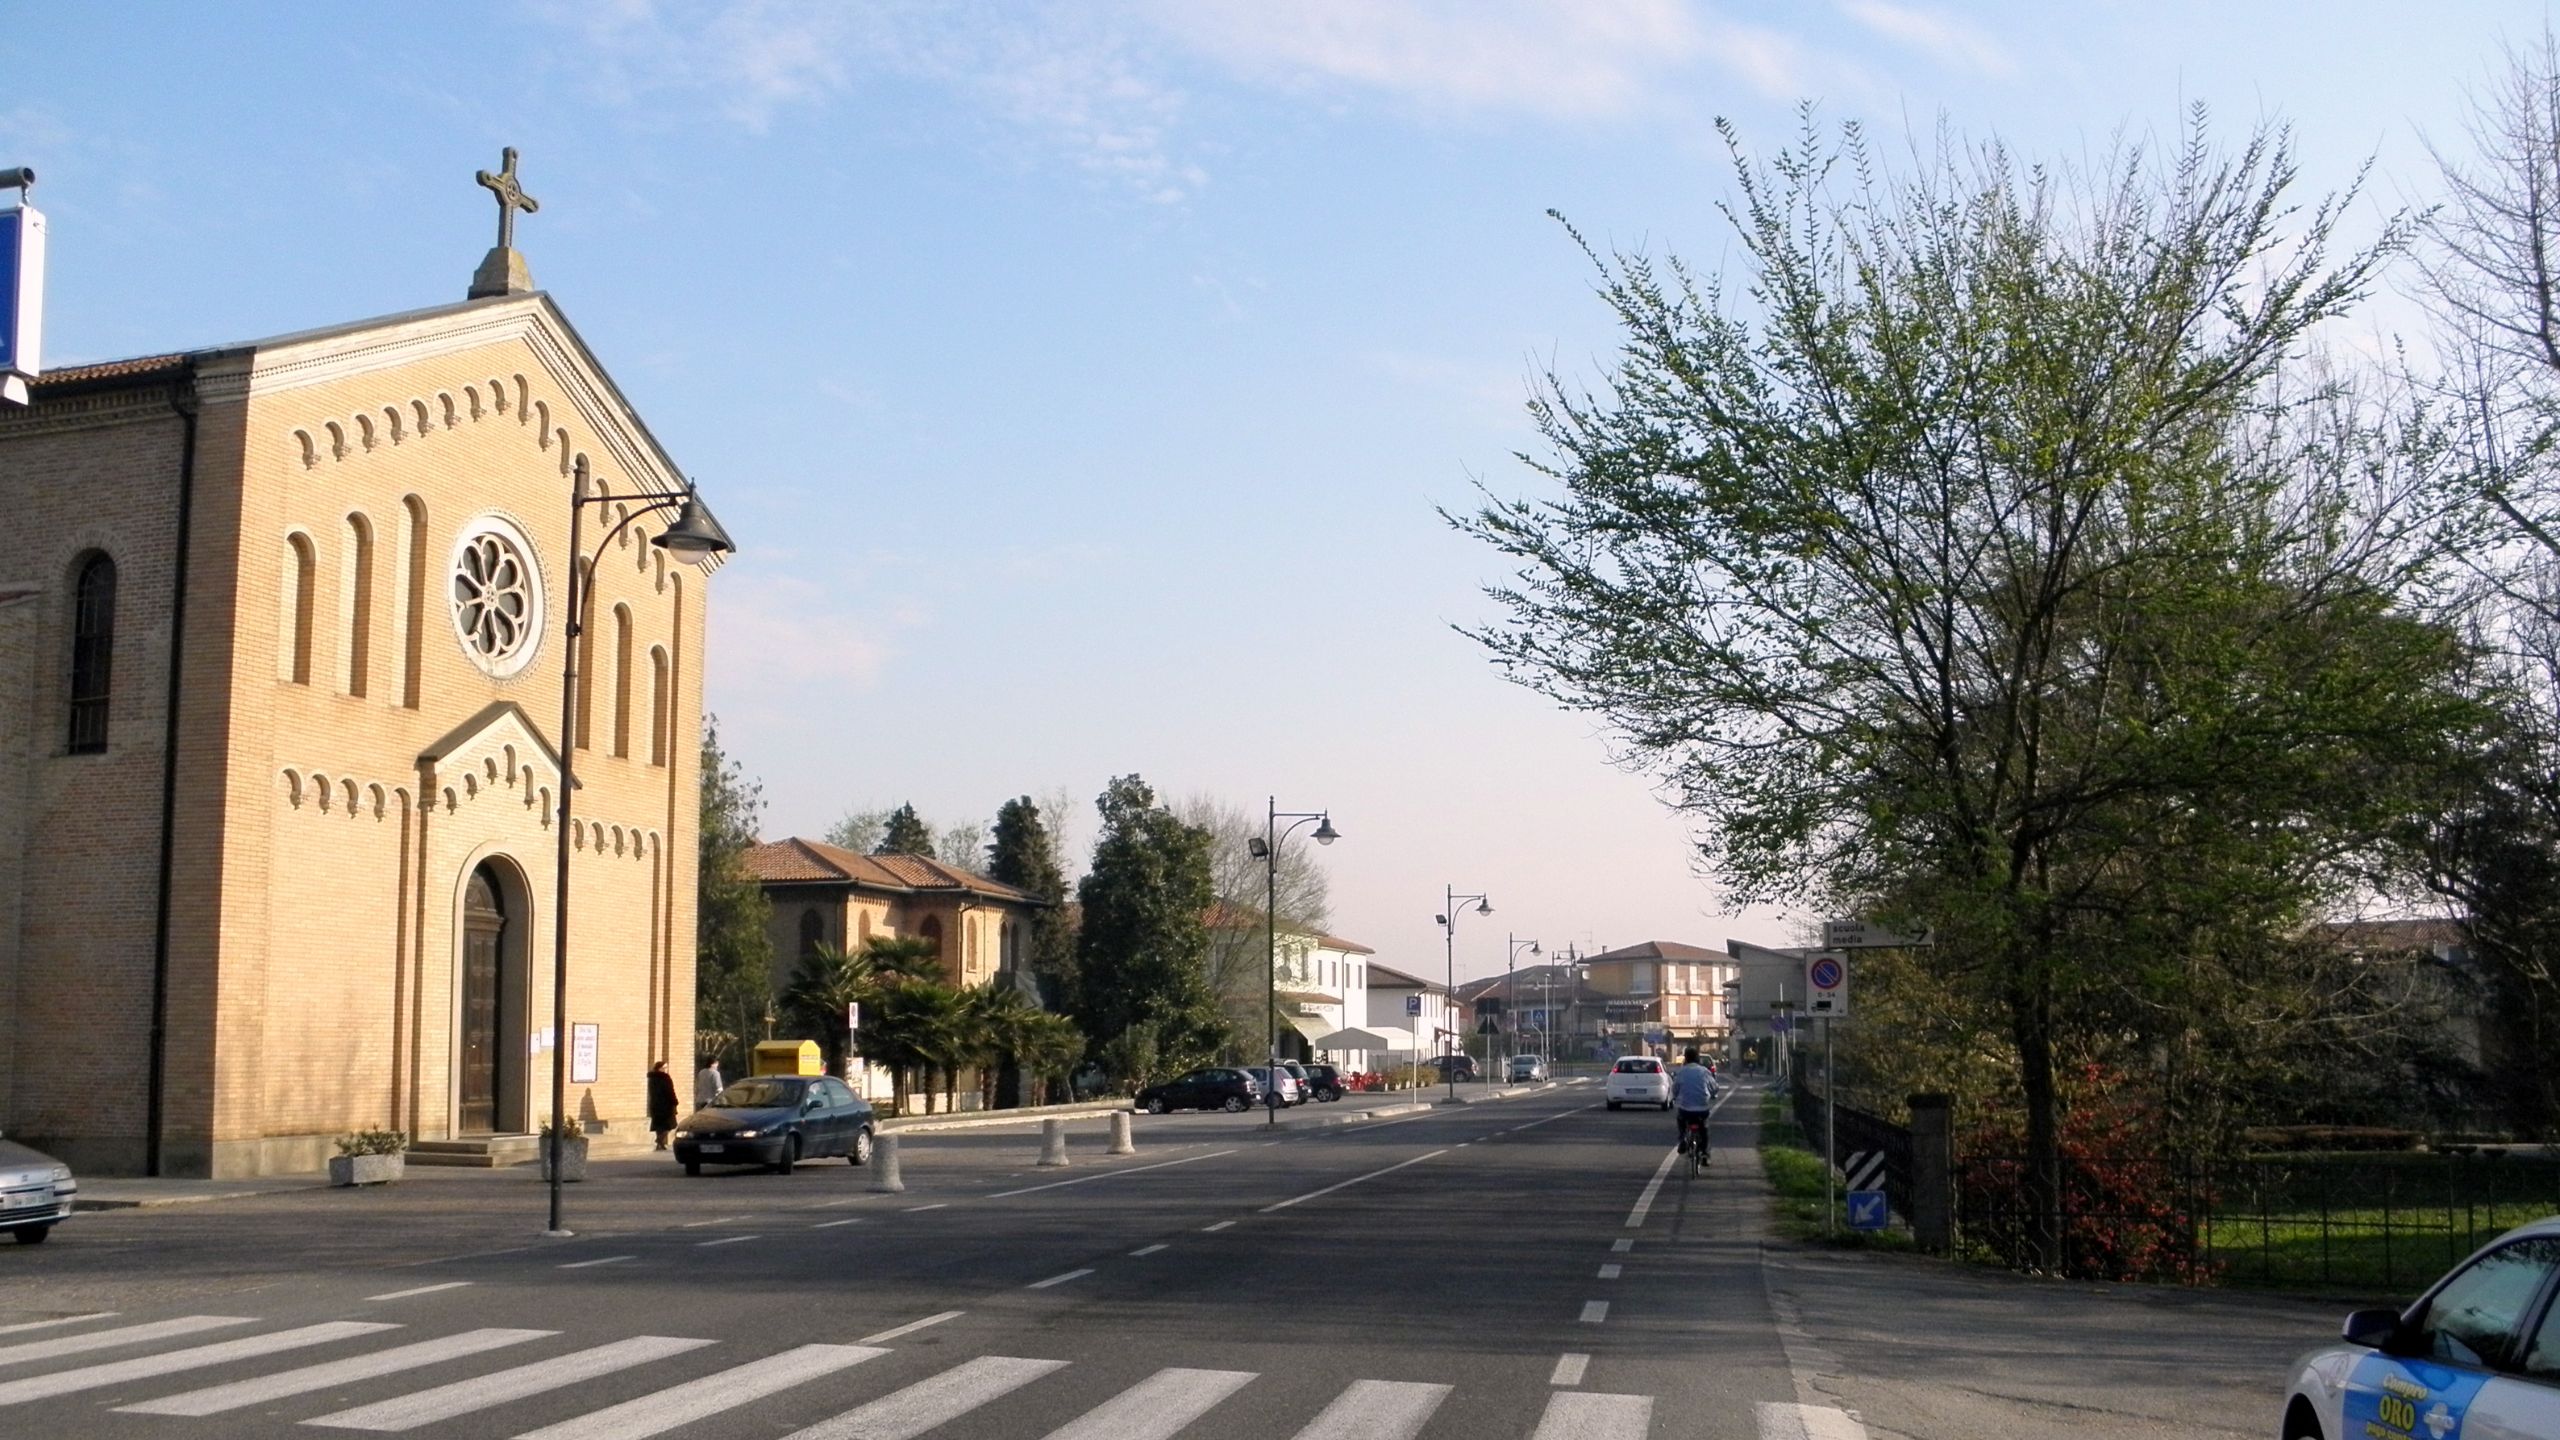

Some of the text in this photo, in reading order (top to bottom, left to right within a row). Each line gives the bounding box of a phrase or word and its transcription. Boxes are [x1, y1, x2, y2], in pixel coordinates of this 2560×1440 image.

[1833, 923, 1865, 933] scuola
[1833, 935, 1862, 944] media
[2383, 1372, 2427, 1400] Compro
[2380, 1394, 2415, 1431] ORO
